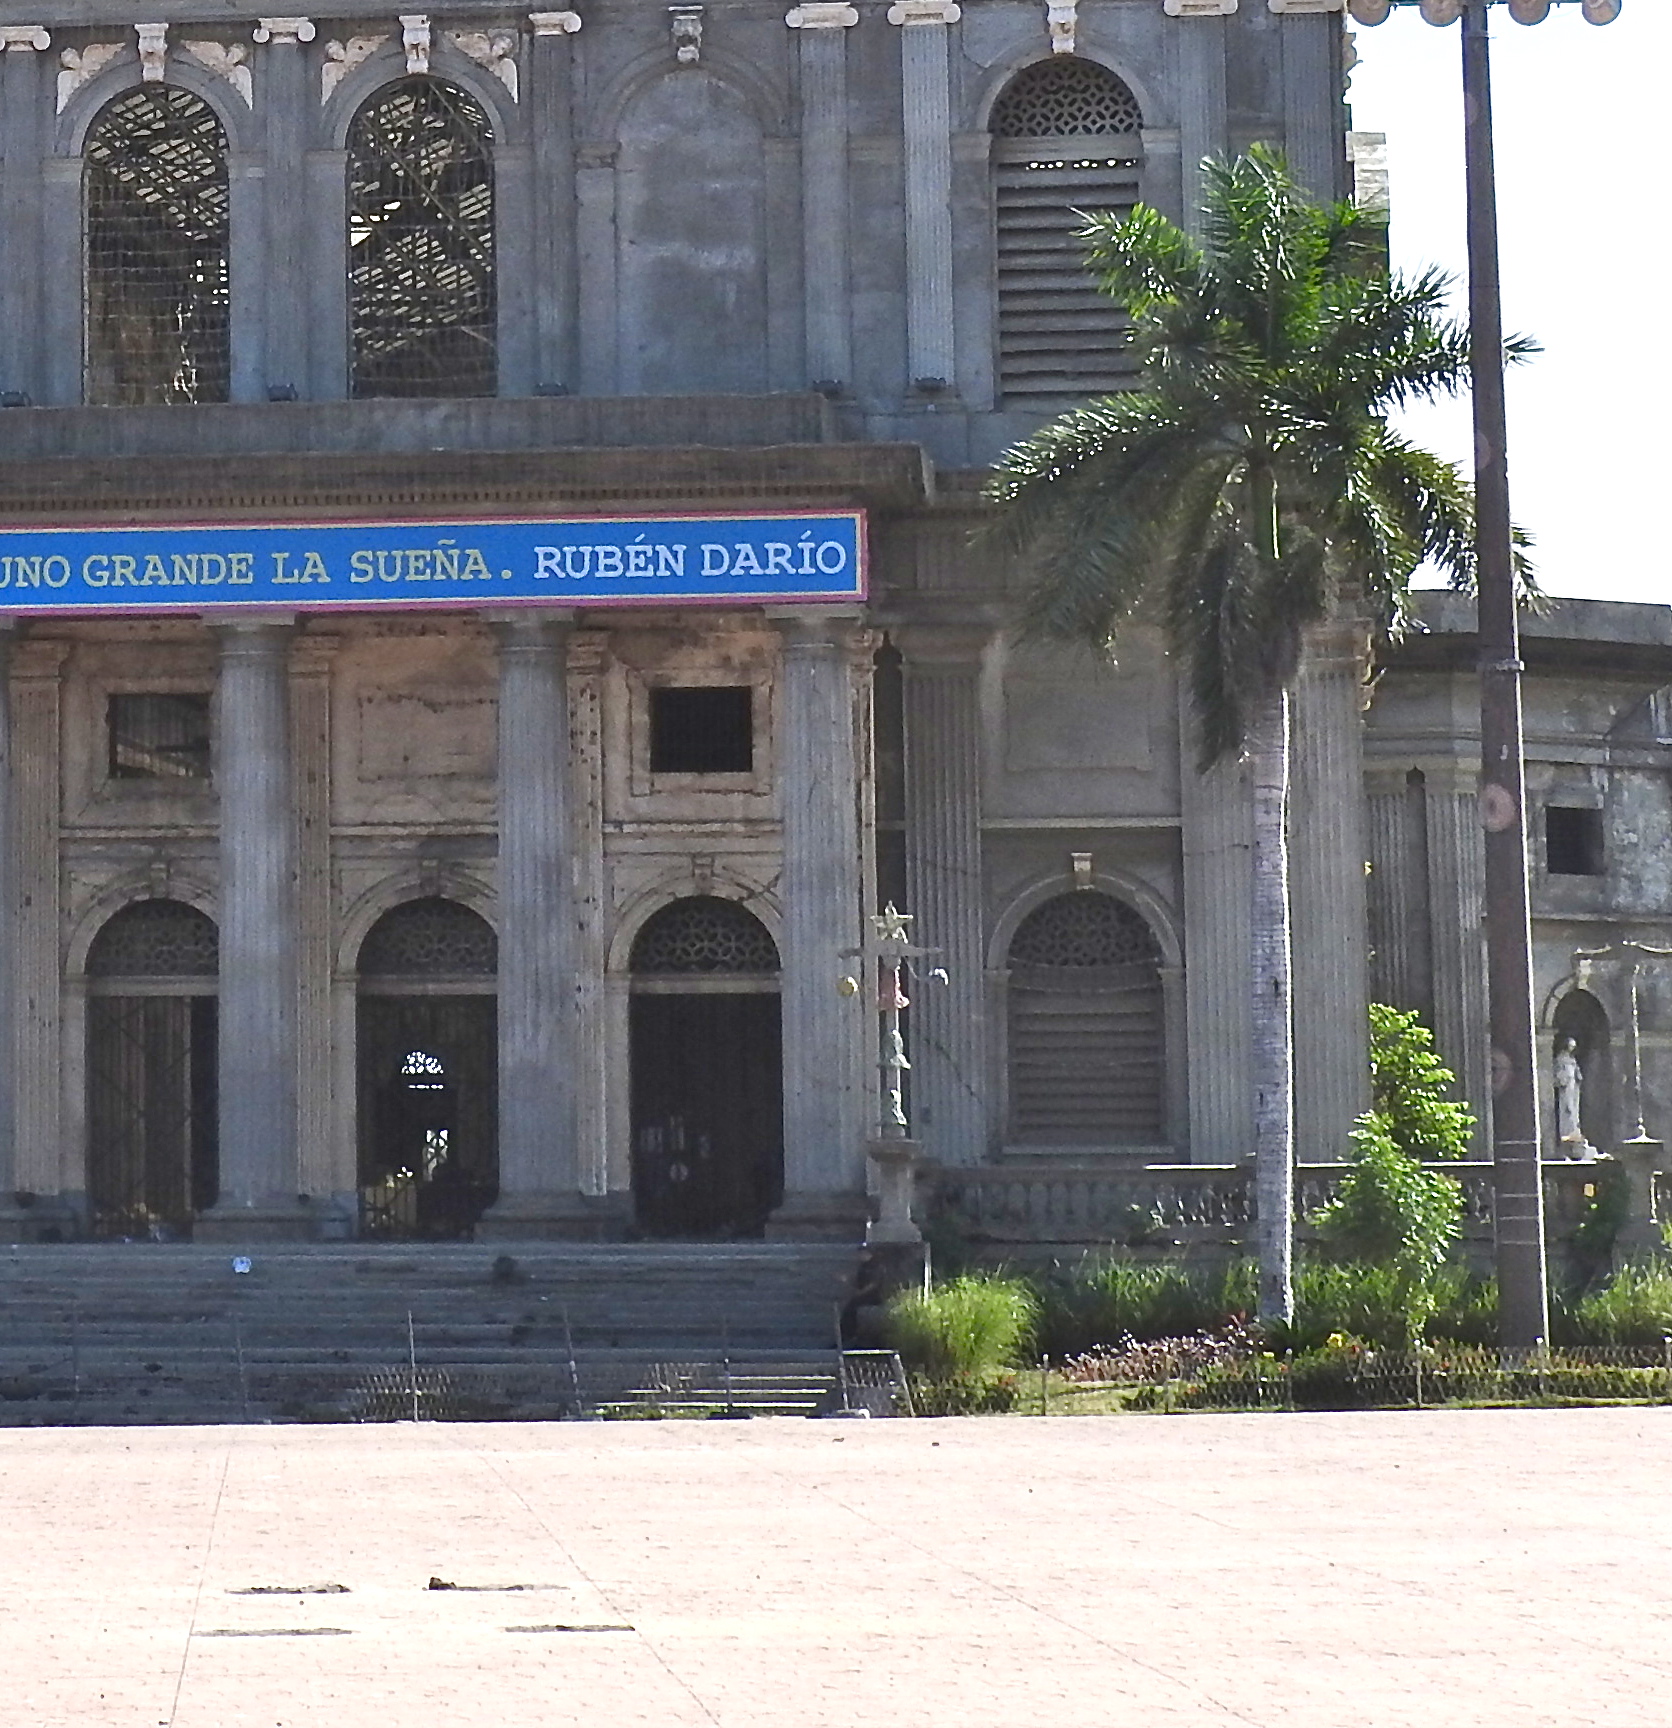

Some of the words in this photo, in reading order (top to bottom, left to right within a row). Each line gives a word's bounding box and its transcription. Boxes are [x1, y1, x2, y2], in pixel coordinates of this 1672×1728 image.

[82, 552, 255, 588] GRANDE
[271, 551, 331, 585] LA
[349, 538, 513, 584] SUEÑA.
[532, 532, 688, 580] RUBÉN
[699, 529, 848, 577] DARÍO
